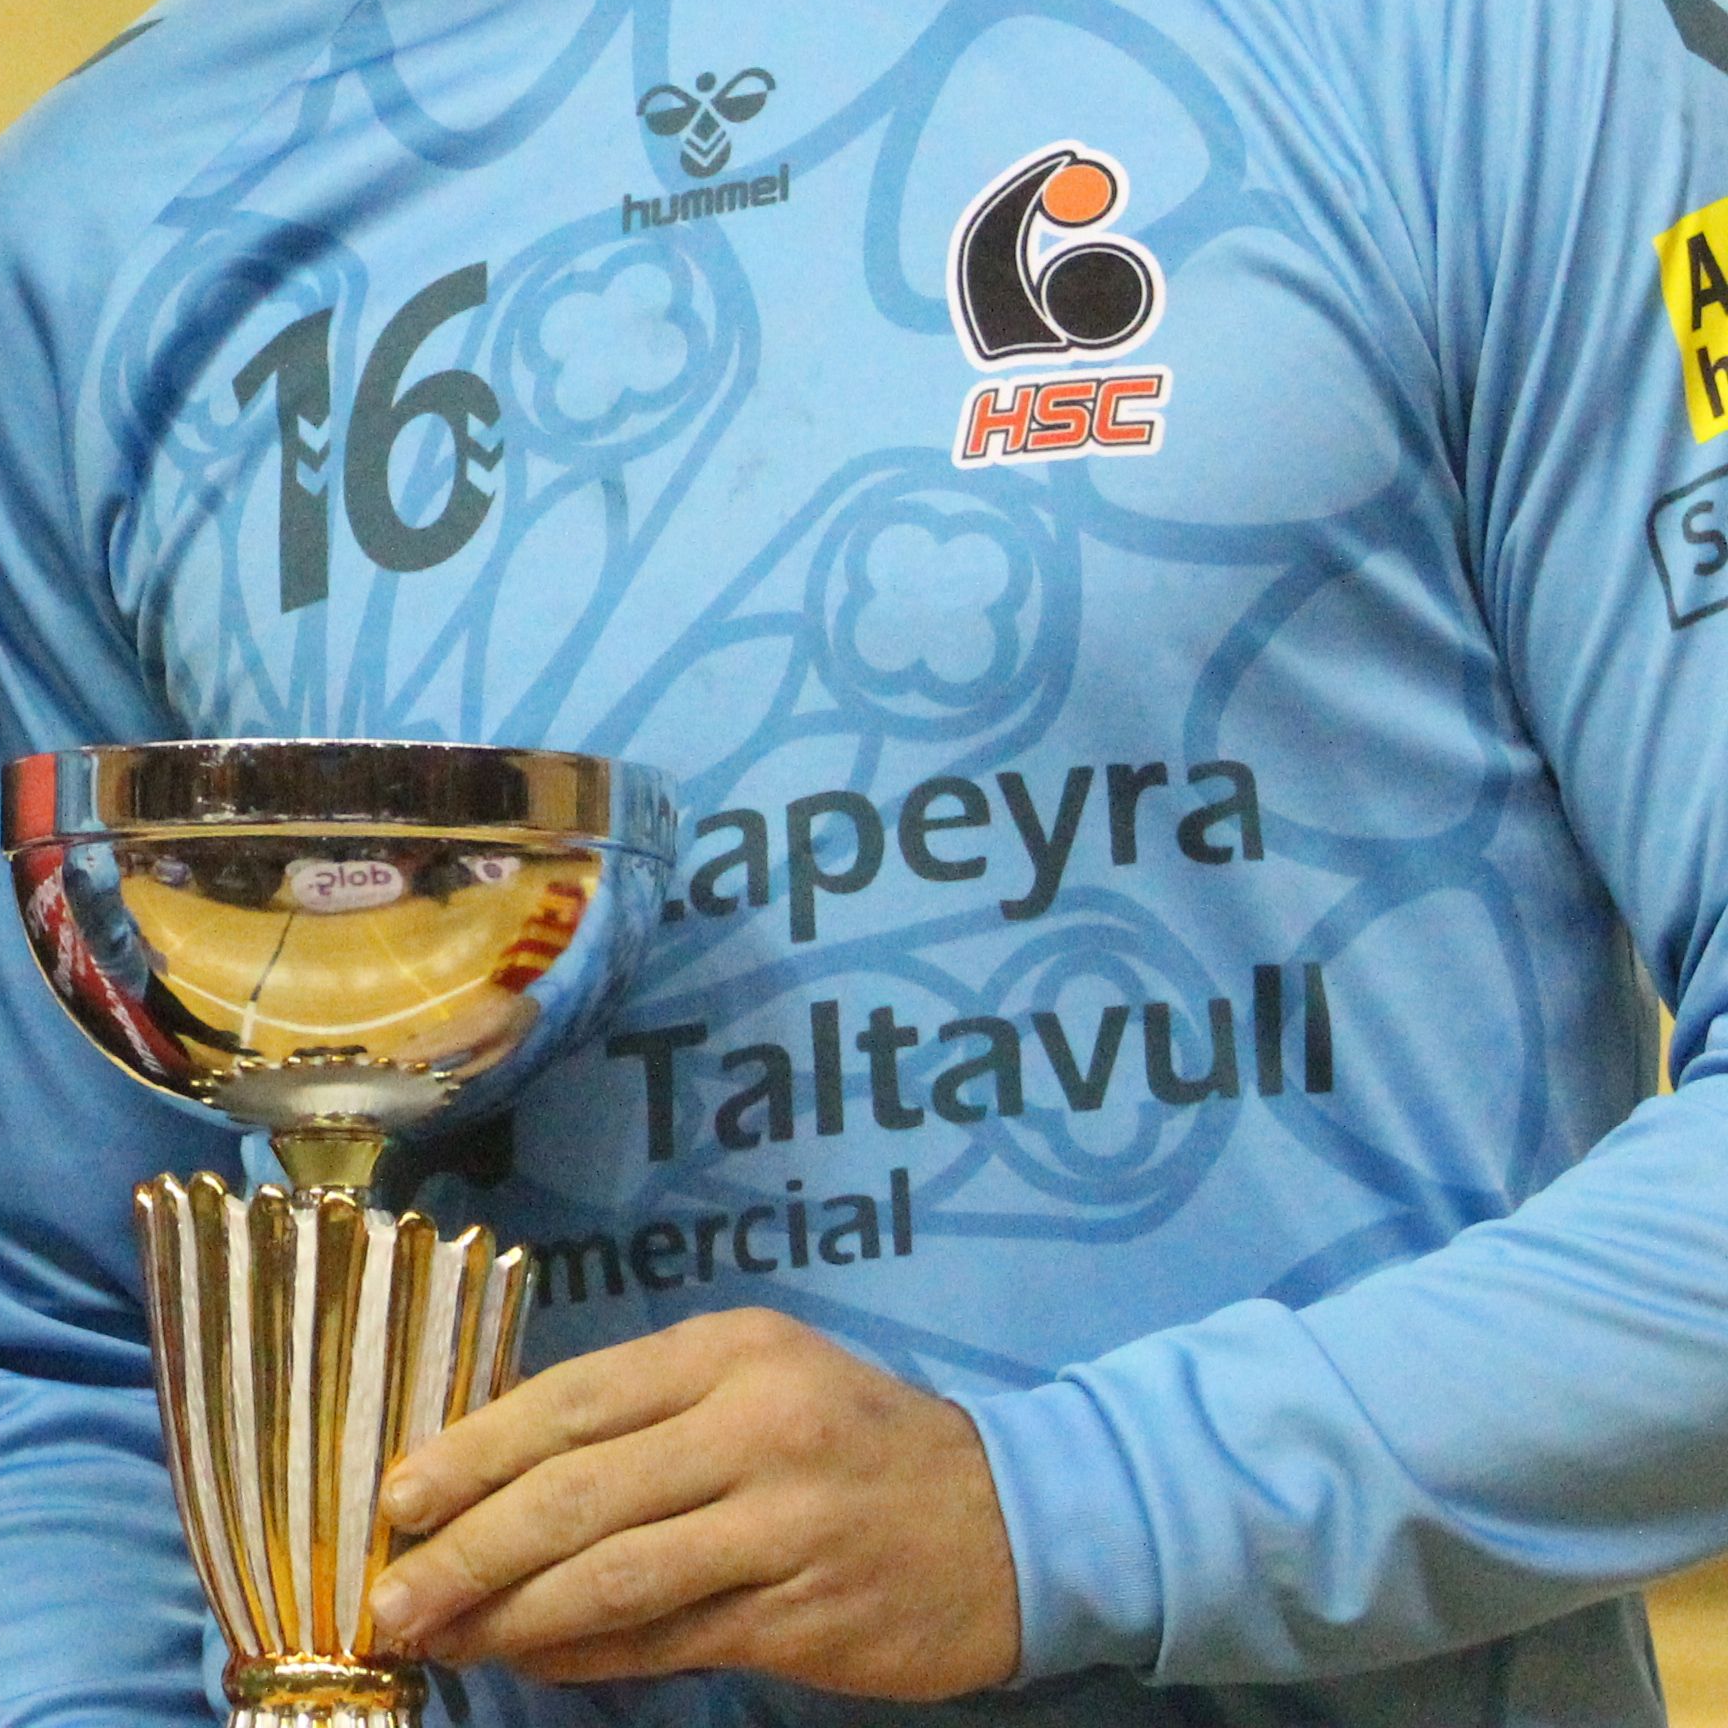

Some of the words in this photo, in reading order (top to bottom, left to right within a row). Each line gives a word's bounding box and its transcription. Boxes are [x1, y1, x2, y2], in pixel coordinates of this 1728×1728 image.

[622, 165, 789, 234] hummel
[232, 261, 505, 614] 16
[962, 374, 1164, 460] HSC
[659, 758, 1266, 944] apeyra
[605, 963, 1334, 1164] Taltavull
[535, 1166, 914, 1309] mercial
